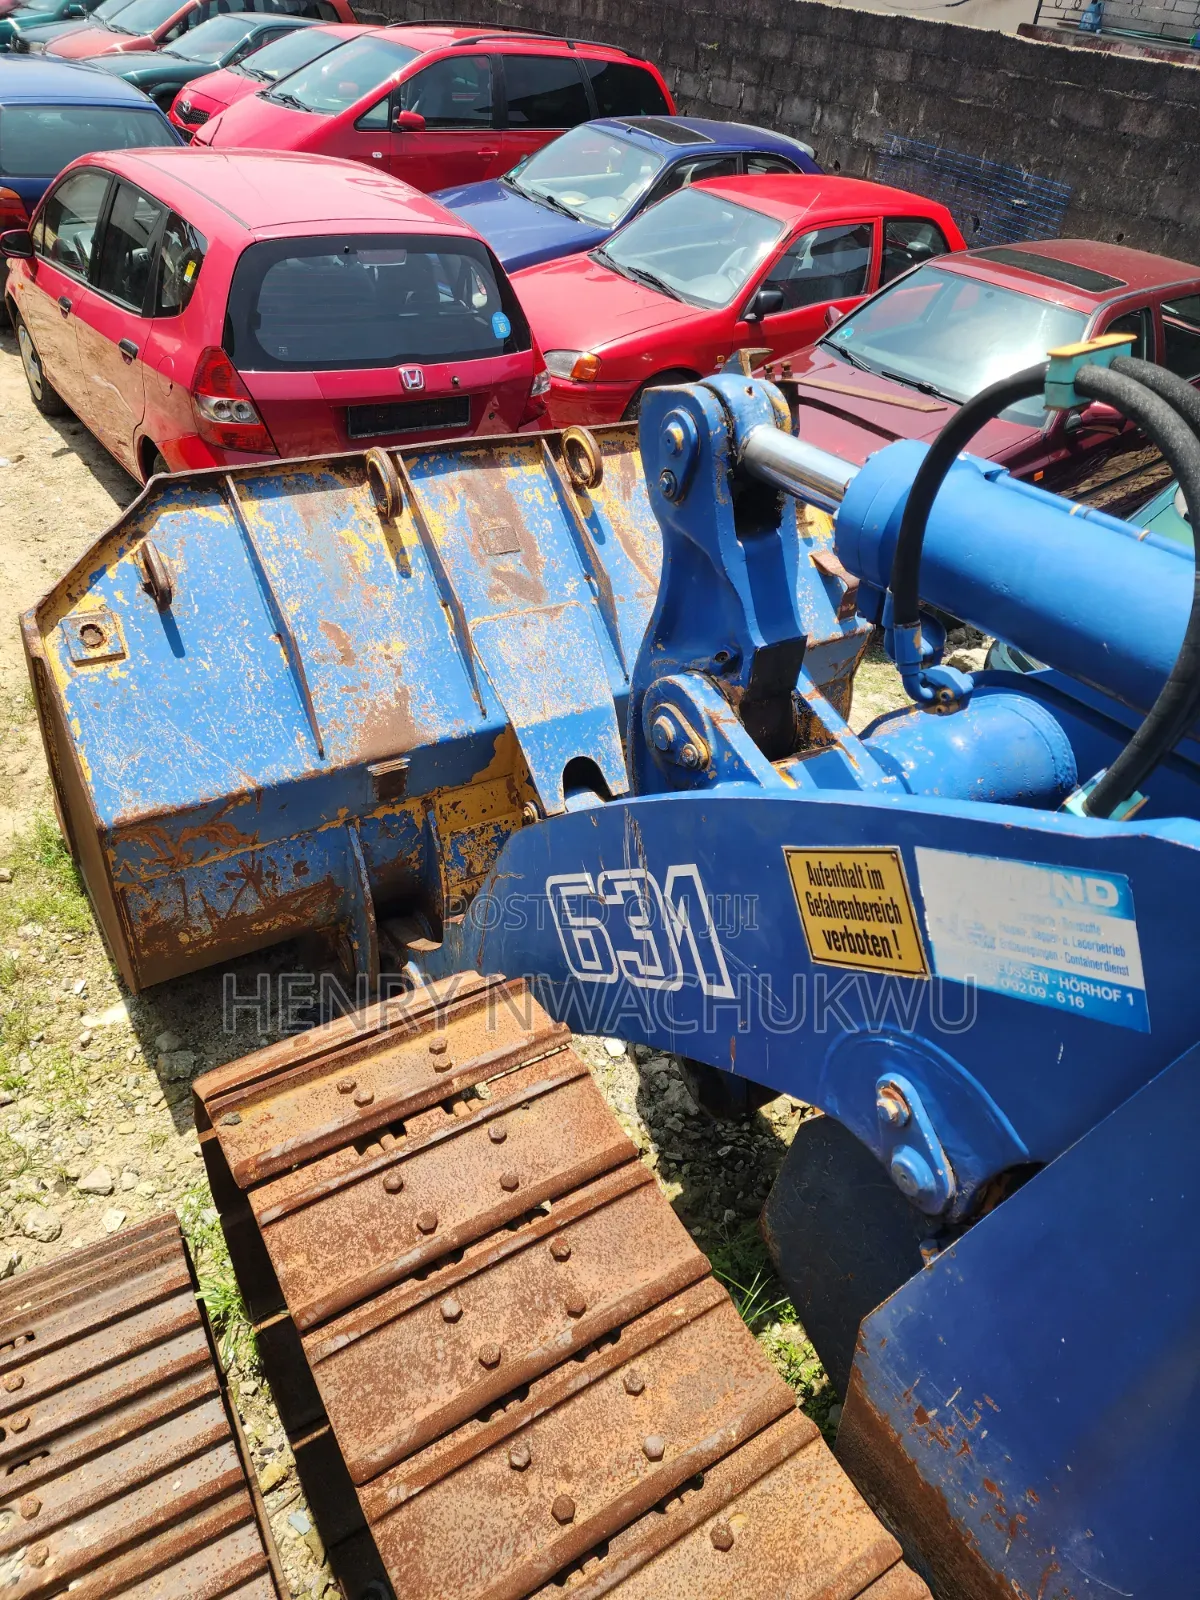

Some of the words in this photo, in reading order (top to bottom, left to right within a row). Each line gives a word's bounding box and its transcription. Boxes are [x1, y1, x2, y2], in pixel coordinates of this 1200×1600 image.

[805, 860, 867, 889] Aufenthalt
[864, 862, 885, 890] im
[805, 891, 903, 925] Gefahrenbereich
[545, 863, 735, 999] 631
[1064, 951, 1130, 977] Containerdienst
[1059, 975, 1122, 1003] HÖRHOF
[1126, 992, 1135, 1007] 1
